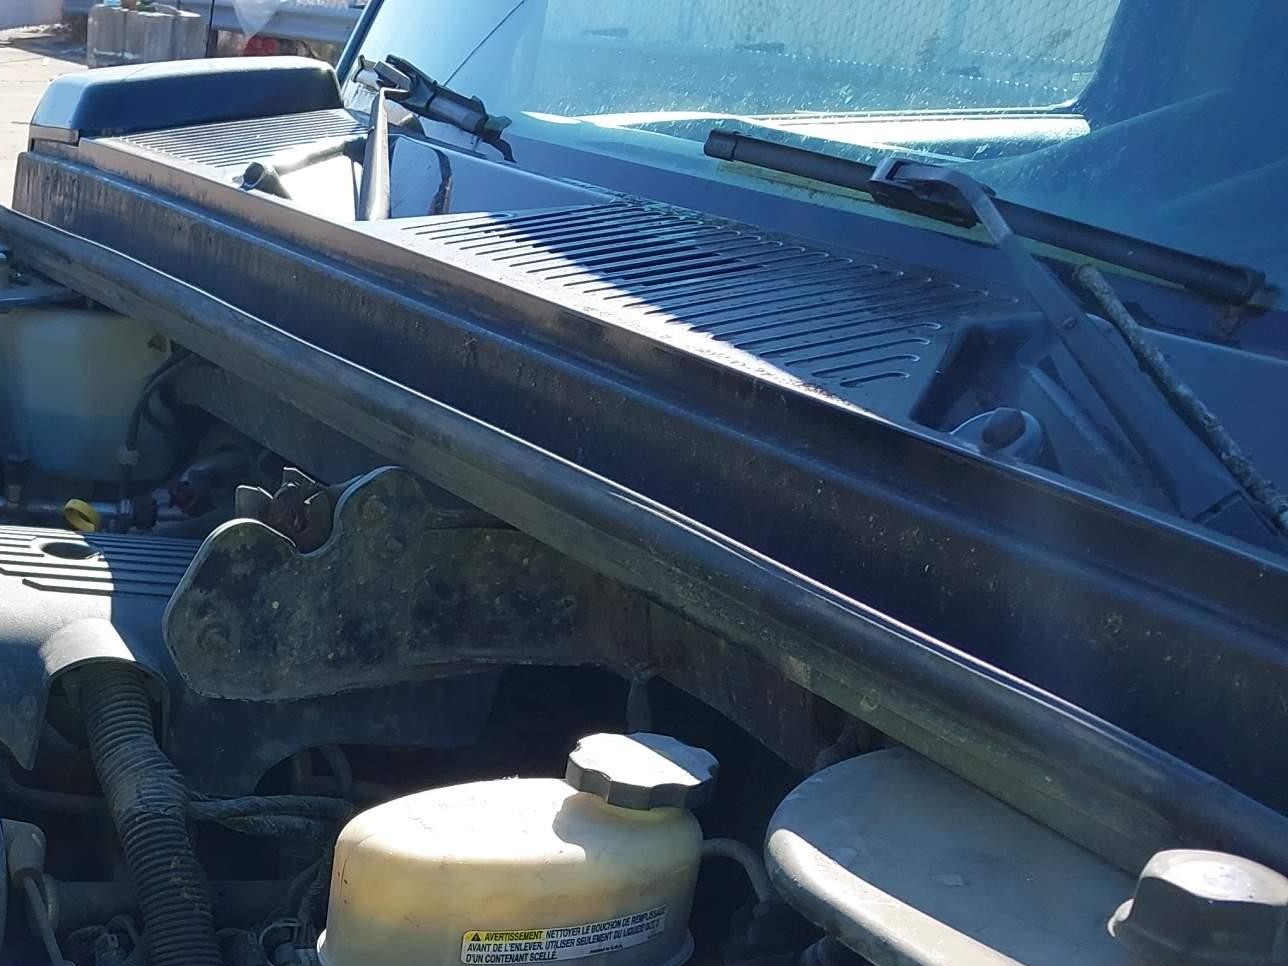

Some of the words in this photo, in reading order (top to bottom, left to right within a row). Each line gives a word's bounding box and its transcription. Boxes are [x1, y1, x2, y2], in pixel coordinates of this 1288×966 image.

[467, 944, 492, 952] AVANT
[493, 943, 503, 952] DE
[545, 938, 575, 950] UTILISER
[576, 933, 612, 946] SEULEMENT
[614, 930, 622, 940] DU
[623, 925, 646, 938] LIQUIDE
[485, 931, 543, 941] AVERTISSEMENT
[546, 927, 581, 938] NETTOYER
[582, 925, 591, 935] LE
[592, 919, 622, 933] BOUCHON
[622, 917, 631, 926] DE
[466, 954, 484, 963] D'UN
[485, 952, 529, 963] CONTENANT
